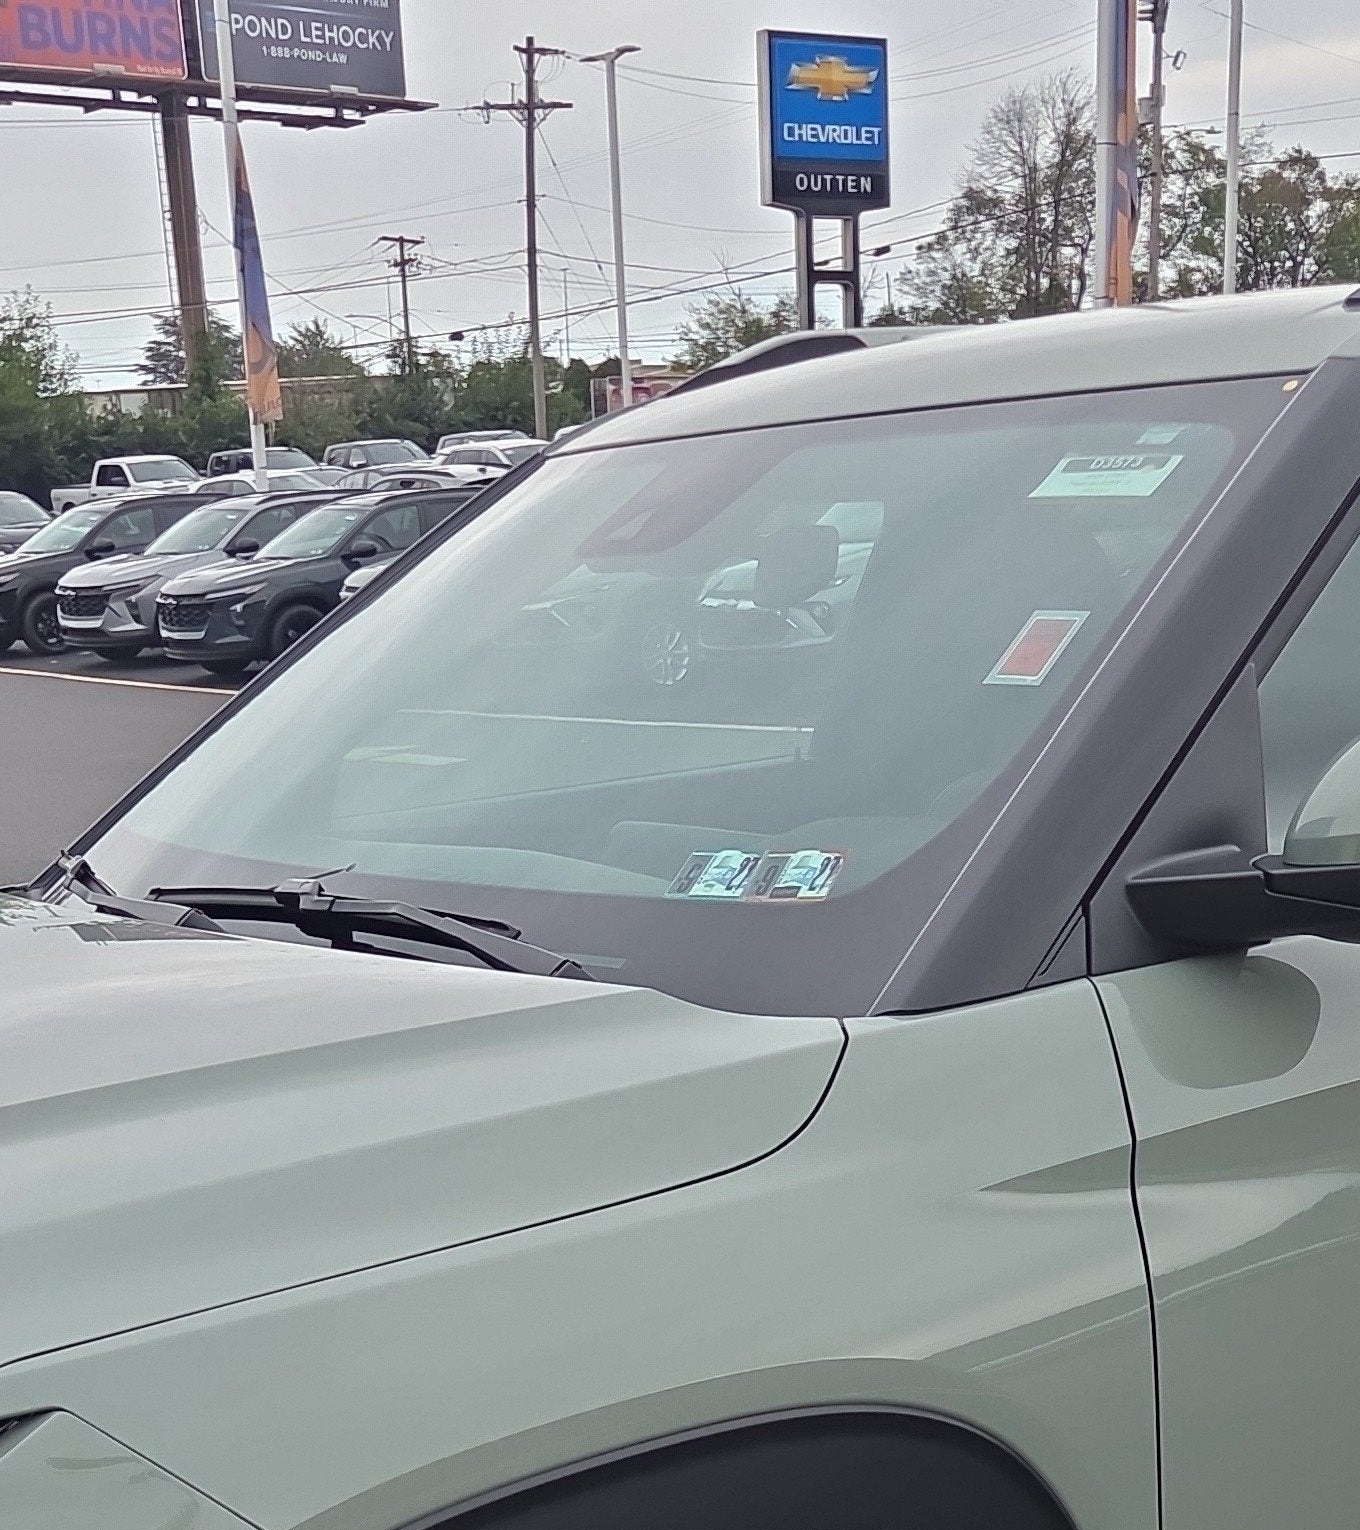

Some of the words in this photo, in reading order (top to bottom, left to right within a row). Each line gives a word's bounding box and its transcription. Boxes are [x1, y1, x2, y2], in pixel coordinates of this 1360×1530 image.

[18, 4, 181, 63] BURNS
[230, 13, 292, 41] POND
[299, 20, 394, 52] LEHOCKY
[783, 122, 882, 146] CHEVROLET
[795, 173, 872, 193] OUTTEN
